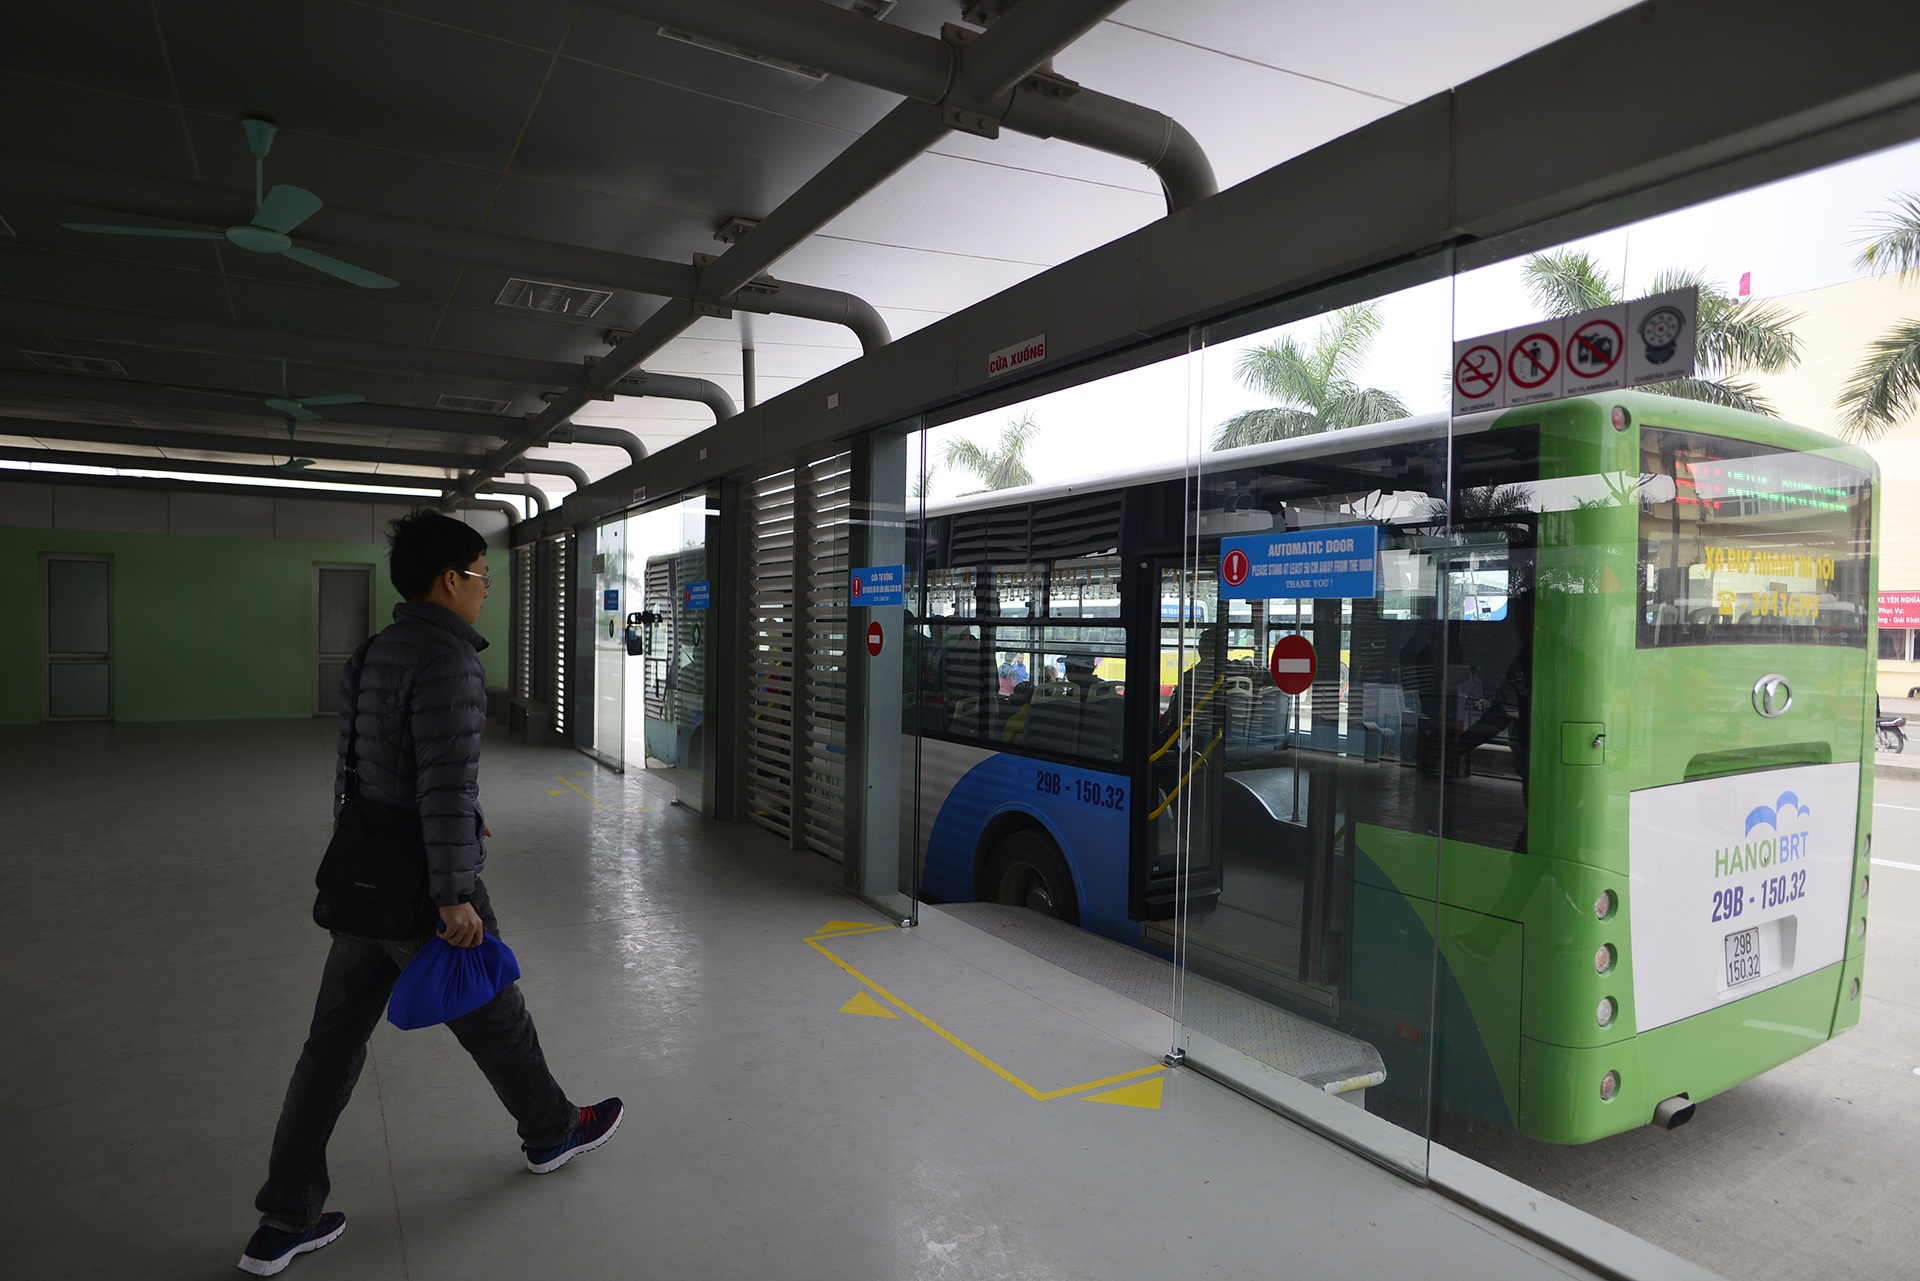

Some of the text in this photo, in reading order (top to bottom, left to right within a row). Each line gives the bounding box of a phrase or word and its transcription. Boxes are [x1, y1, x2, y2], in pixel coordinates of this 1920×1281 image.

[990, 344, 1044, 373] CỬA XUỐNG
[1268, 538, 1354, 557] AUTOMATIC DOOR
[1252, 564, 1268, 577] PLEASE
[1268, 563, 1283, 576] STAND
[1283, 562, 1289, 575] AT
[1289, 561, 1304, 575] LEAST
[1319, 560, 1334, 573] AWAY
[1334, 559, 1349, 573] FROM
[1349, 559, 1359, 572] THE
[1359, 558, 1373, 572] DOOR
[1728, 548, 1752, 574] BUS
[1285, 580, 1311, 589] THANK
[1313, 579, 1329, 587] YOU
[1751, 592, 1819, 619] 38436393
[1878, 607, 1893, 615] Phục
[1887, 595, 1899, 604] YÊN
[1036, 770, 1061, 795] 29B
[1075, 779, 1125, 811] 150.32
[1715, 831, 1809, 878] HANOI BRT
[1711, 885, 1744, 923] 29B
[1761, 869, 1806, 909] 150.32
[1733, 933, 1752, 958] 29B
[1728, 954, 1760, 983] 150.32
